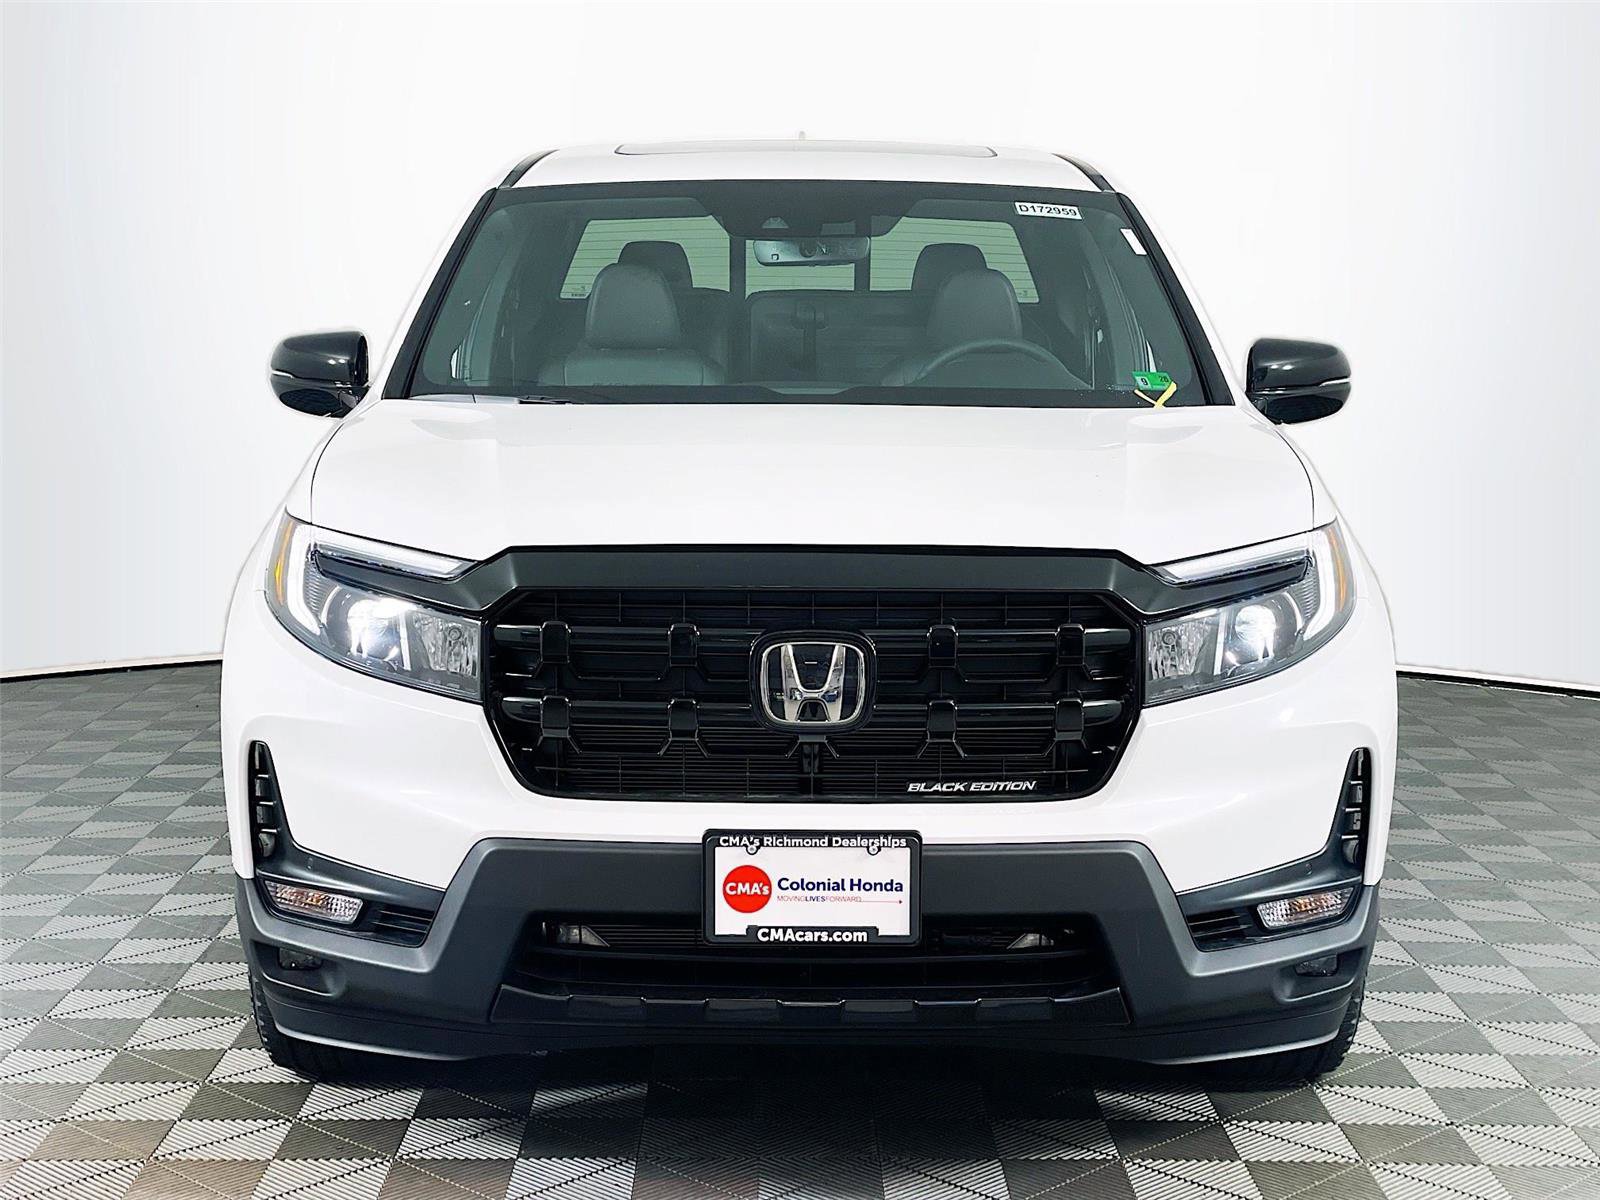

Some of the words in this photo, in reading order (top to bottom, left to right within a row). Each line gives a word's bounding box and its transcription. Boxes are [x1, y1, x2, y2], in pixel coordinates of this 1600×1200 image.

[1018, 204, 1077, 217] D172959
[907, 782, 967, 792] BLACK
[969, 781, 1037, 792] EDITION
[720, 835, 760, 847] CMA's
[763, 835, 828, 847] Richmond
[832, 835, 907, 848] Dealerships
[725, 882, 769, 896] CMA's
[777, 877, 845, 892] Colonial
[849, 878, 903, 892] Honda
[757, 927, 868, 943] CMAcars.com
